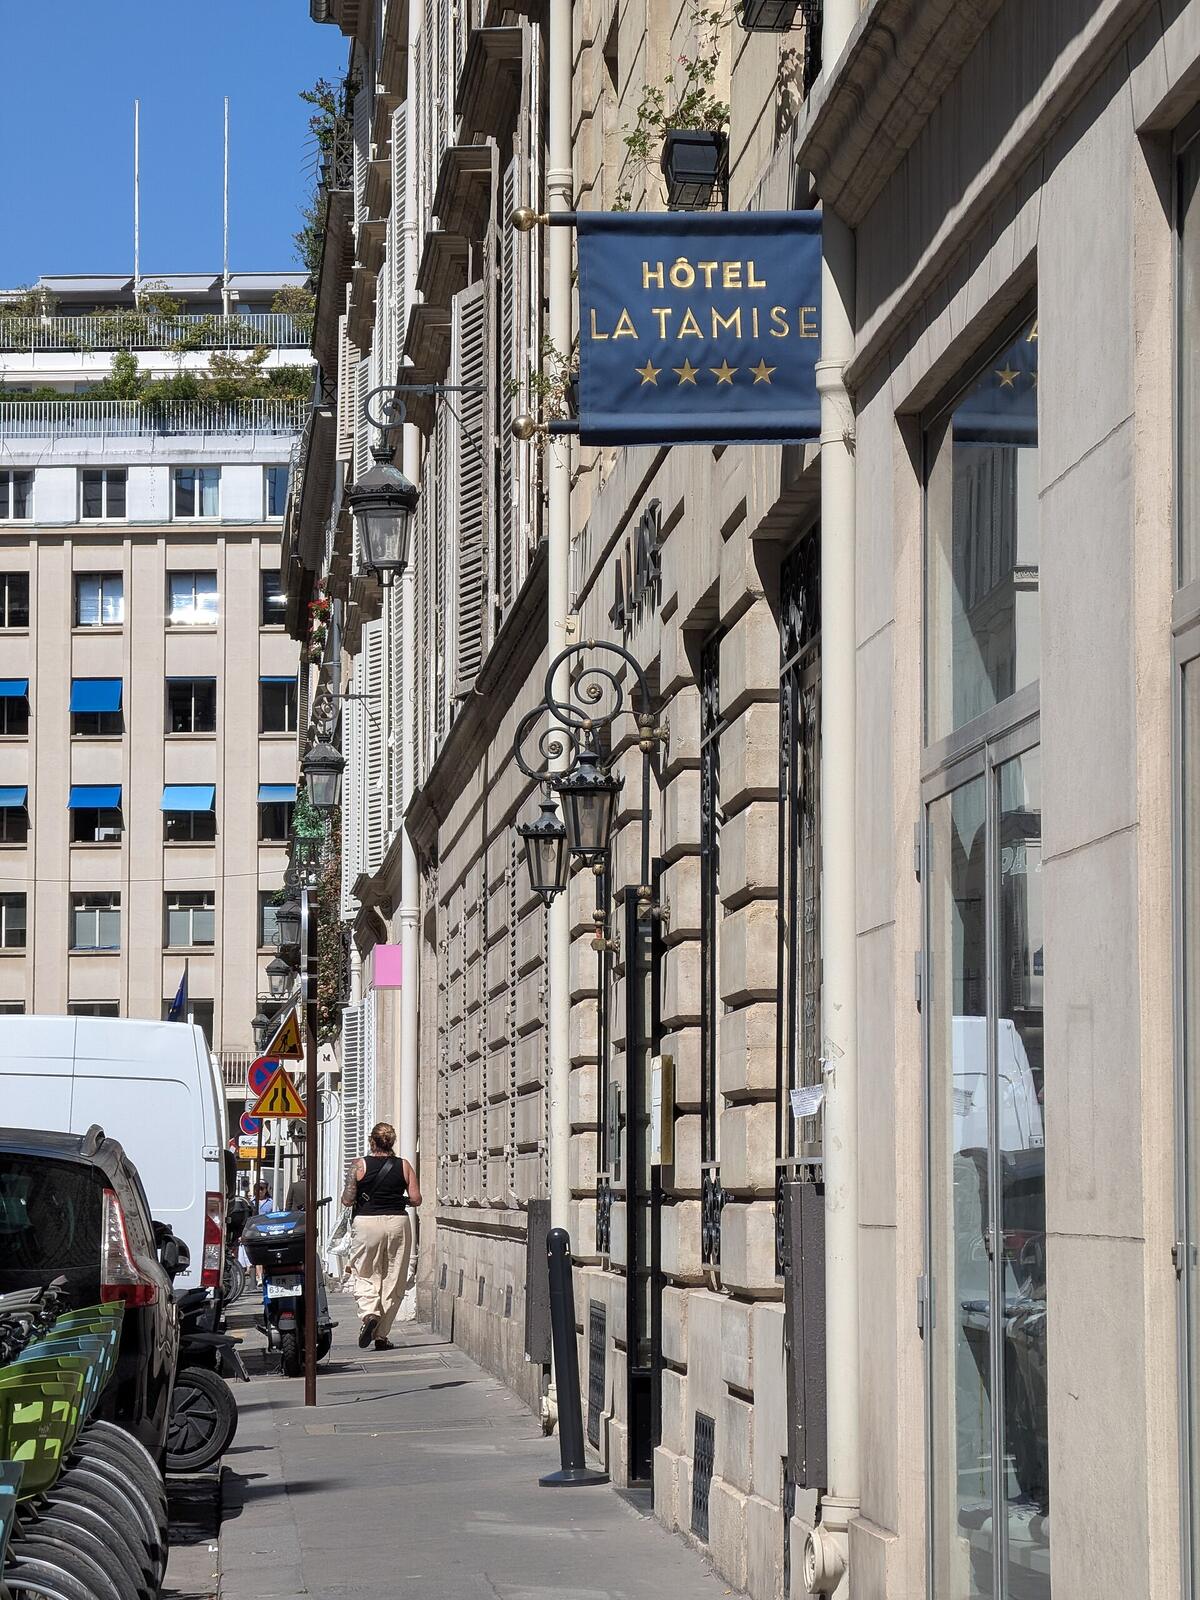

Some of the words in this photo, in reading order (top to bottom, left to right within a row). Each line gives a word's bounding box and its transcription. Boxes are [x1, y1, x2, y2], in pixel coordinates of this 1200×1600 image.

[641, 256, 767, 290] HÔTEL
[590, 307, 639, 340] LA
[651, 306, 819, 340] TAMISE
